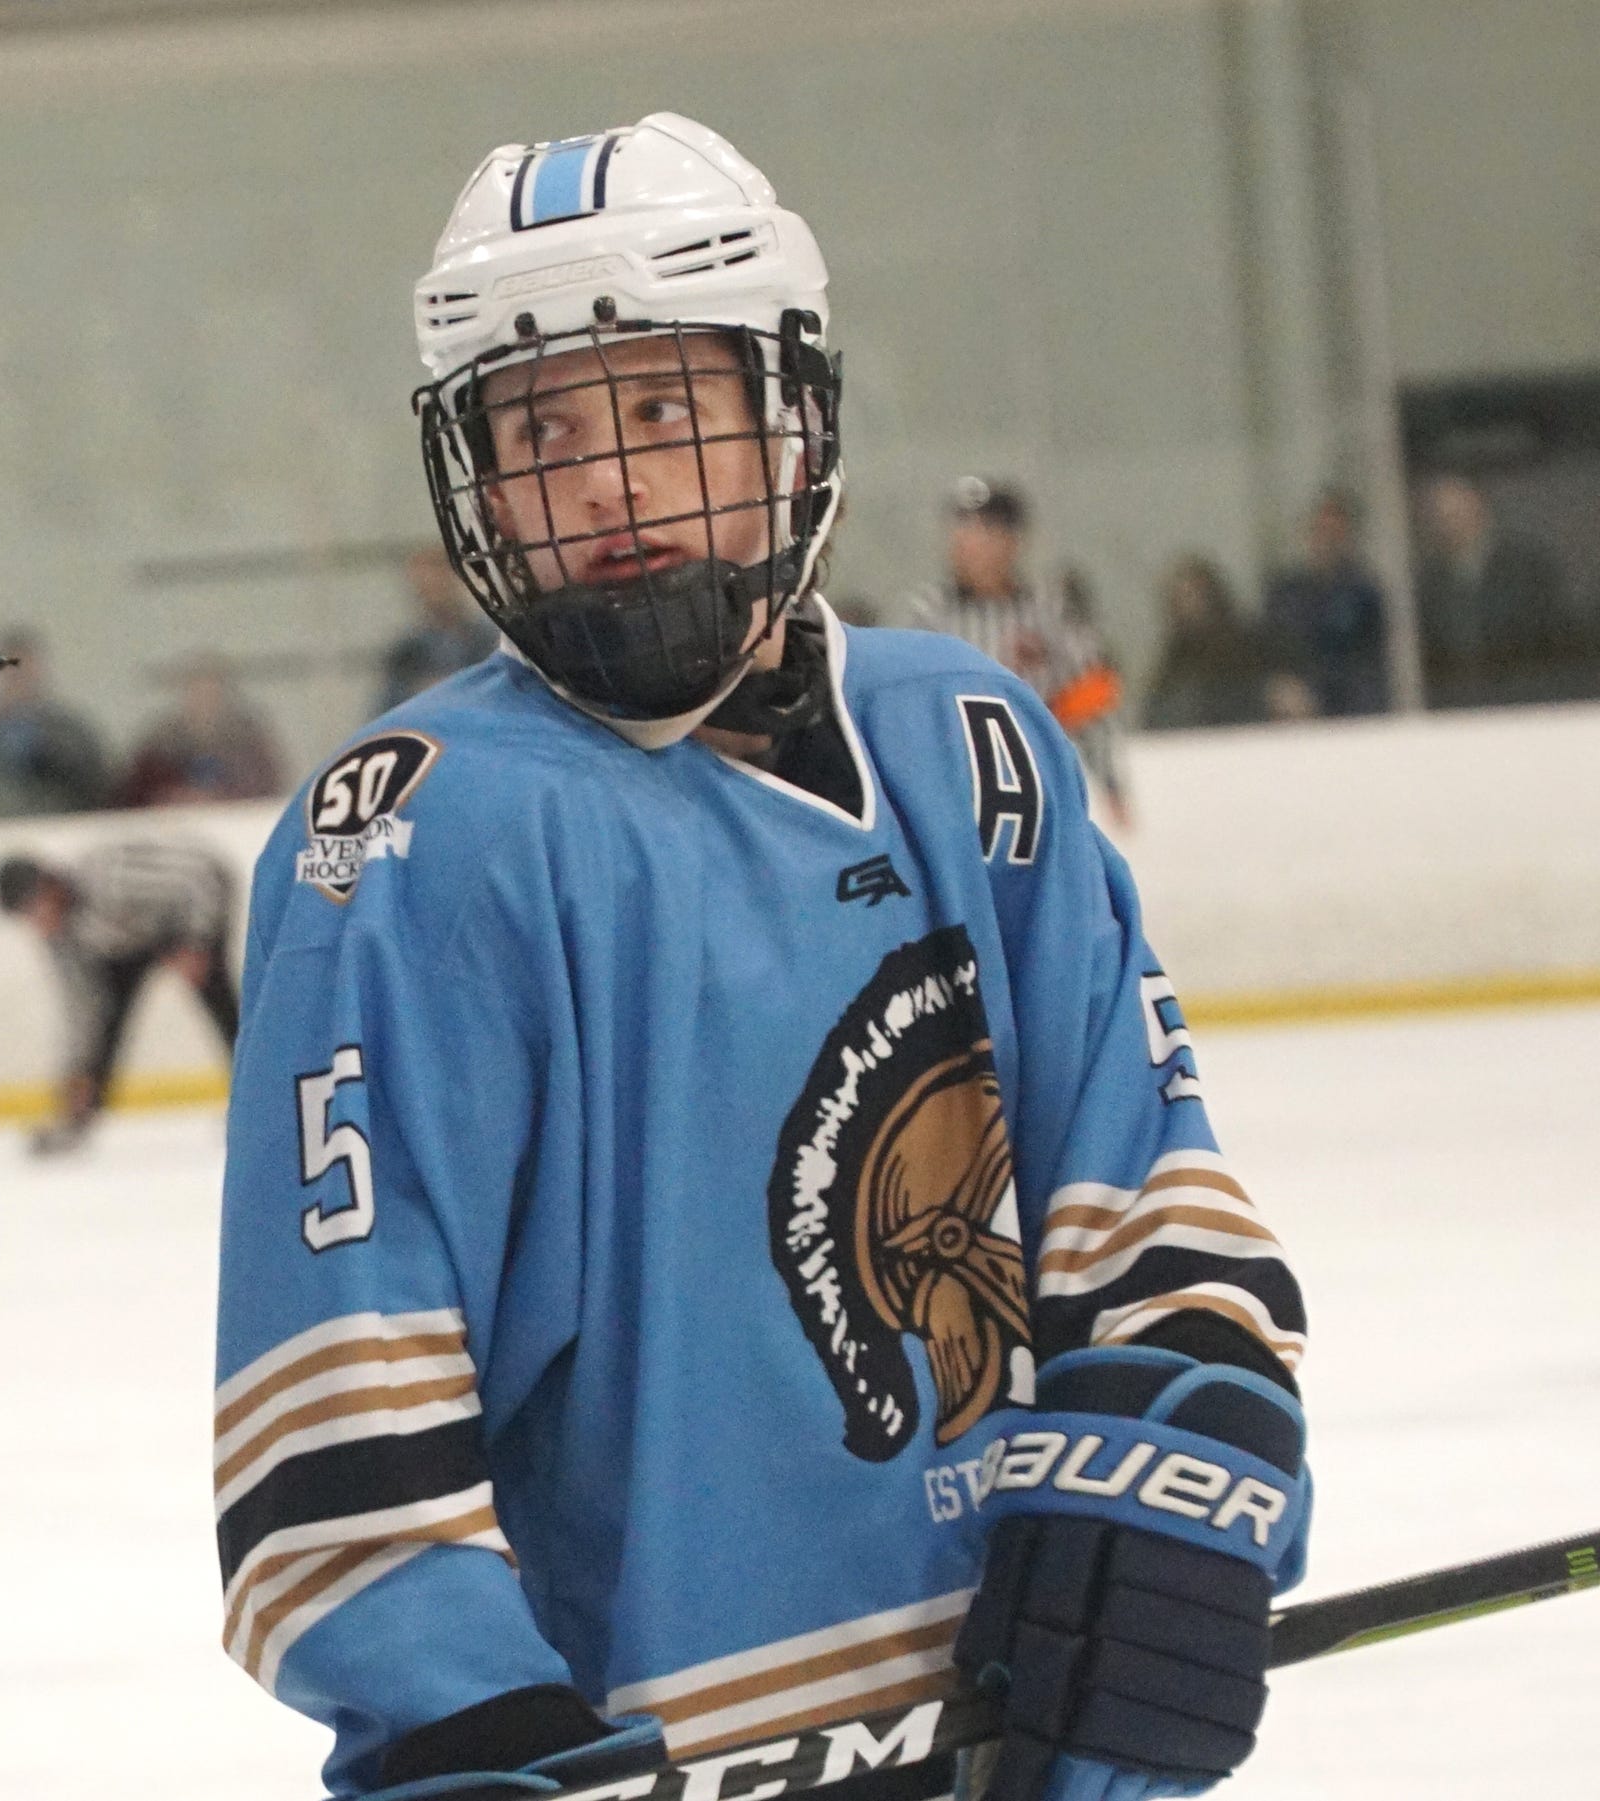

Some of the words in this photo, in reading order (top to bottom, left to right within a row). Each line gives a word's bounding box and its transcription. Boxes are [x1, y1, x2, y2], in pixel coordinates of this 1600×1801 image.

[315, 750, 399, 828] 50
[955, 694, 1043, 865] A
[295, 1043, 375, 1255] 5
[552, 1700, 944, 1801] CM
